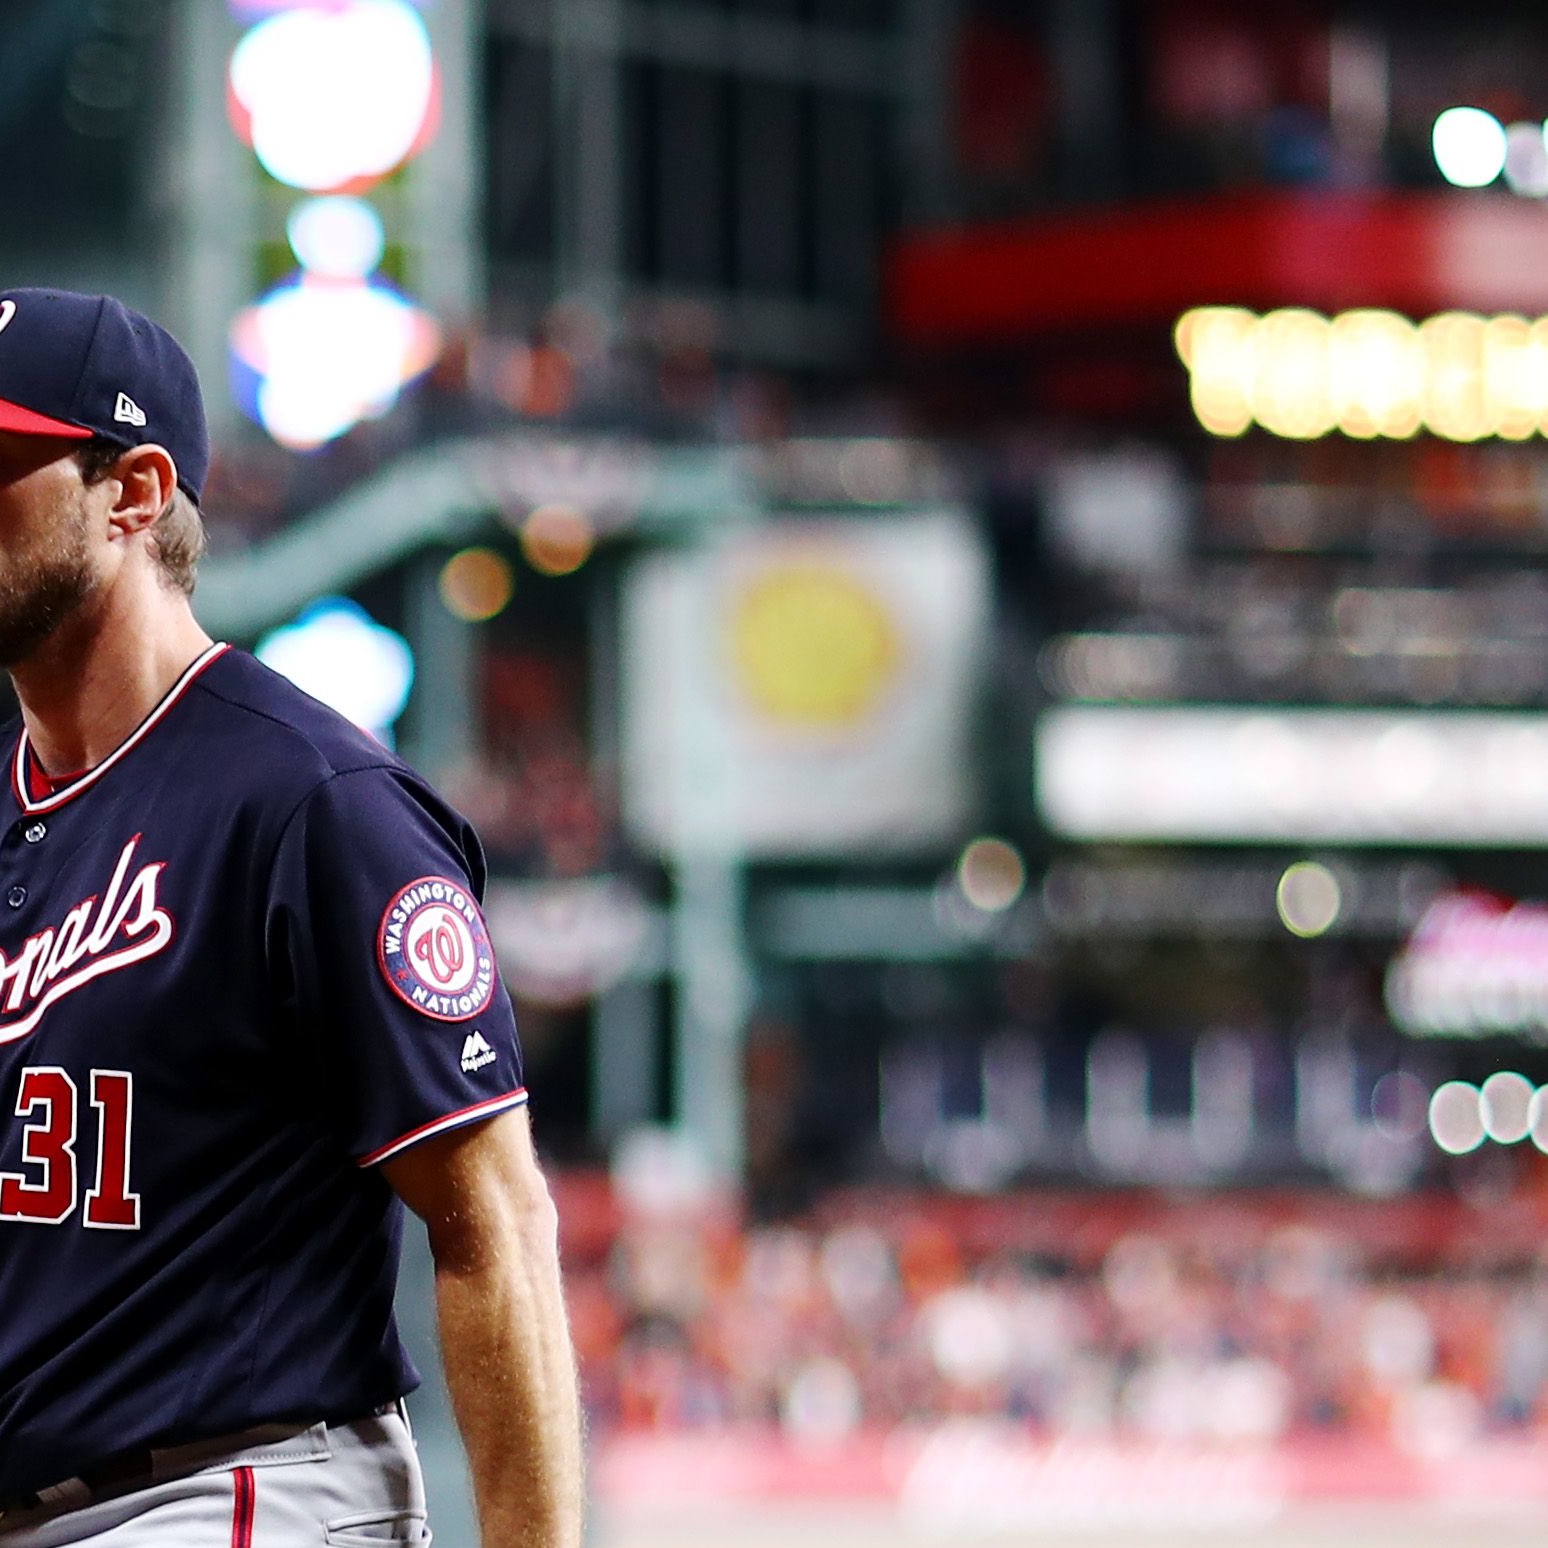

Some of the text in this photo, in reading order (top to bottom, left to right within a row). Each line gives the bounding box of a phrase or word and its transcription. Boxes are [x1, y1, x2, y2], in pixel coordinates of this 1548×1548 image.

[385, 882, 476, 955] WASHINGTON
[414, 914, 464, 984] W
[412, 956, 491, 1016] NATIONALS
